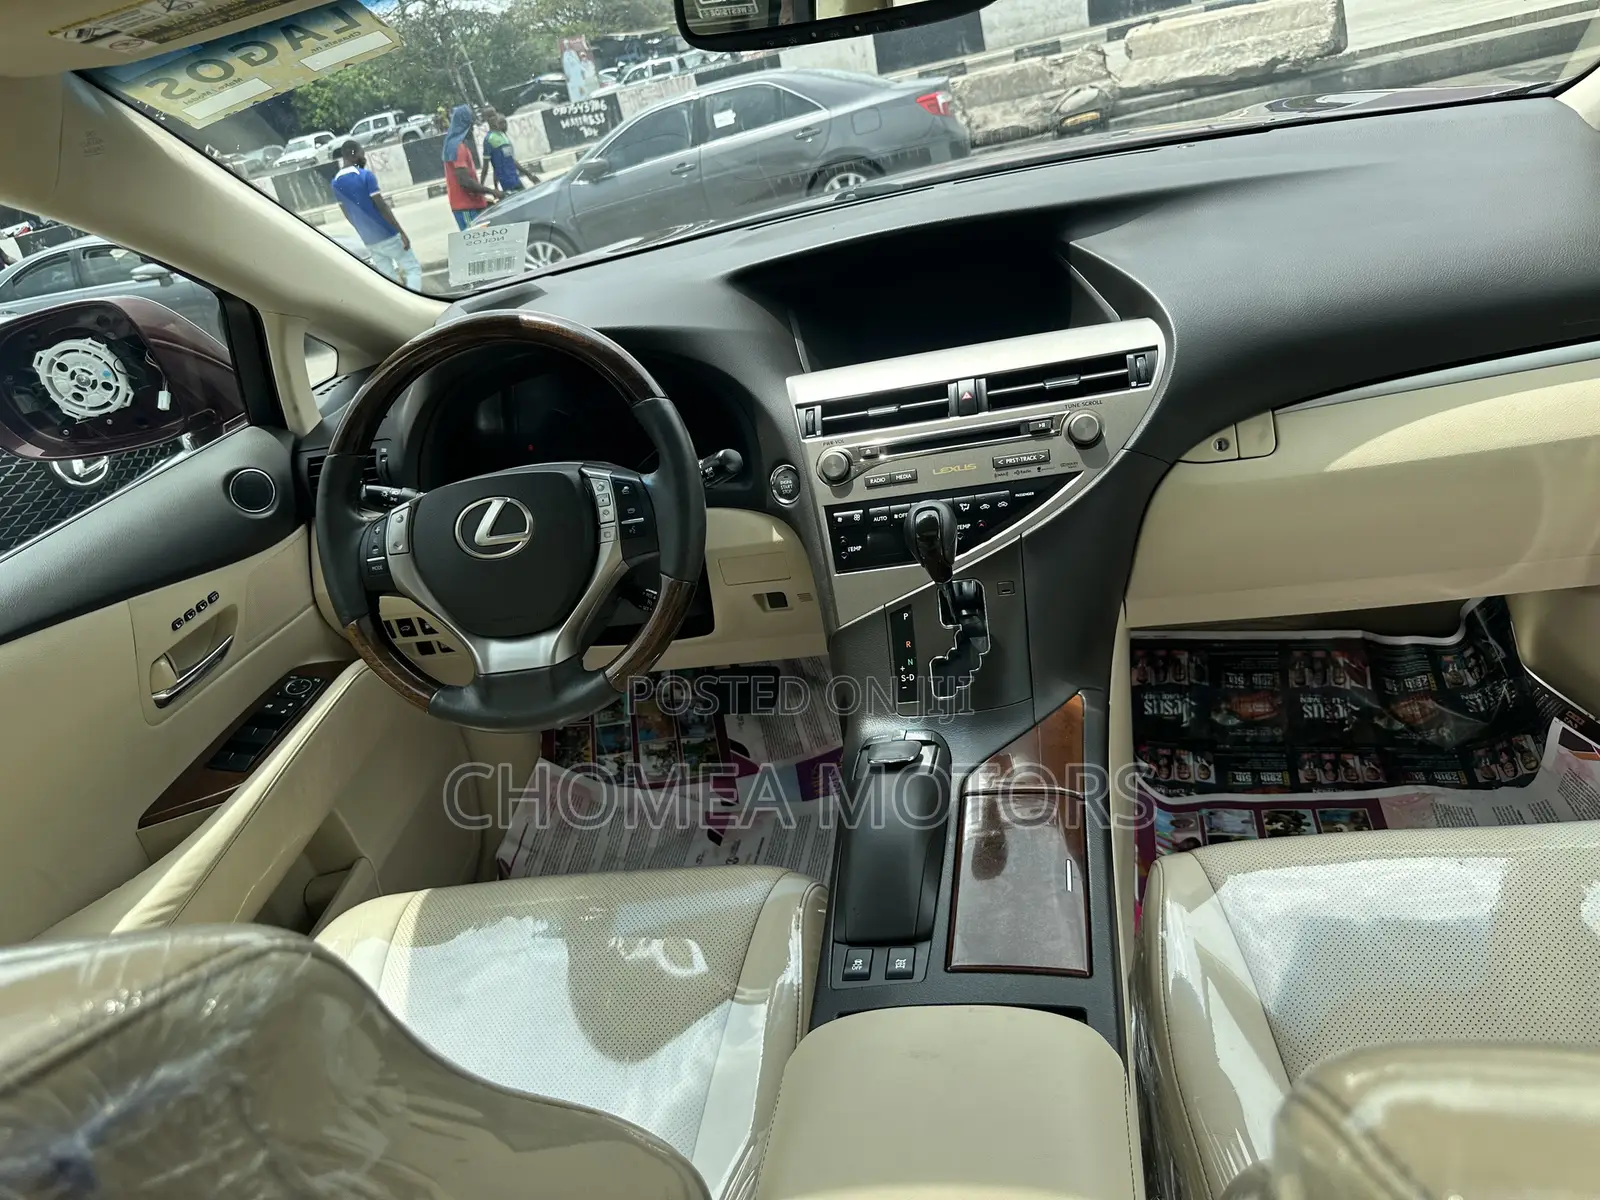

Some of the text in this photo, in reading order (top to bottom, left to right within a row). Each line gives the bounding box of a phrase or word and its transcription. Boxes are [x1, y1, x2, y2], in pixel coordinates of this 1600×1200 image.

[932, 463, 977, 476] LEXUS
[869, 477, 886, 485] RADIO
[895, 473, 912, 481] MEDIA
[847, 545, 862, 553] TEMP
[905, 640, 911, 648] R
[907, 658, 914, 666] N
